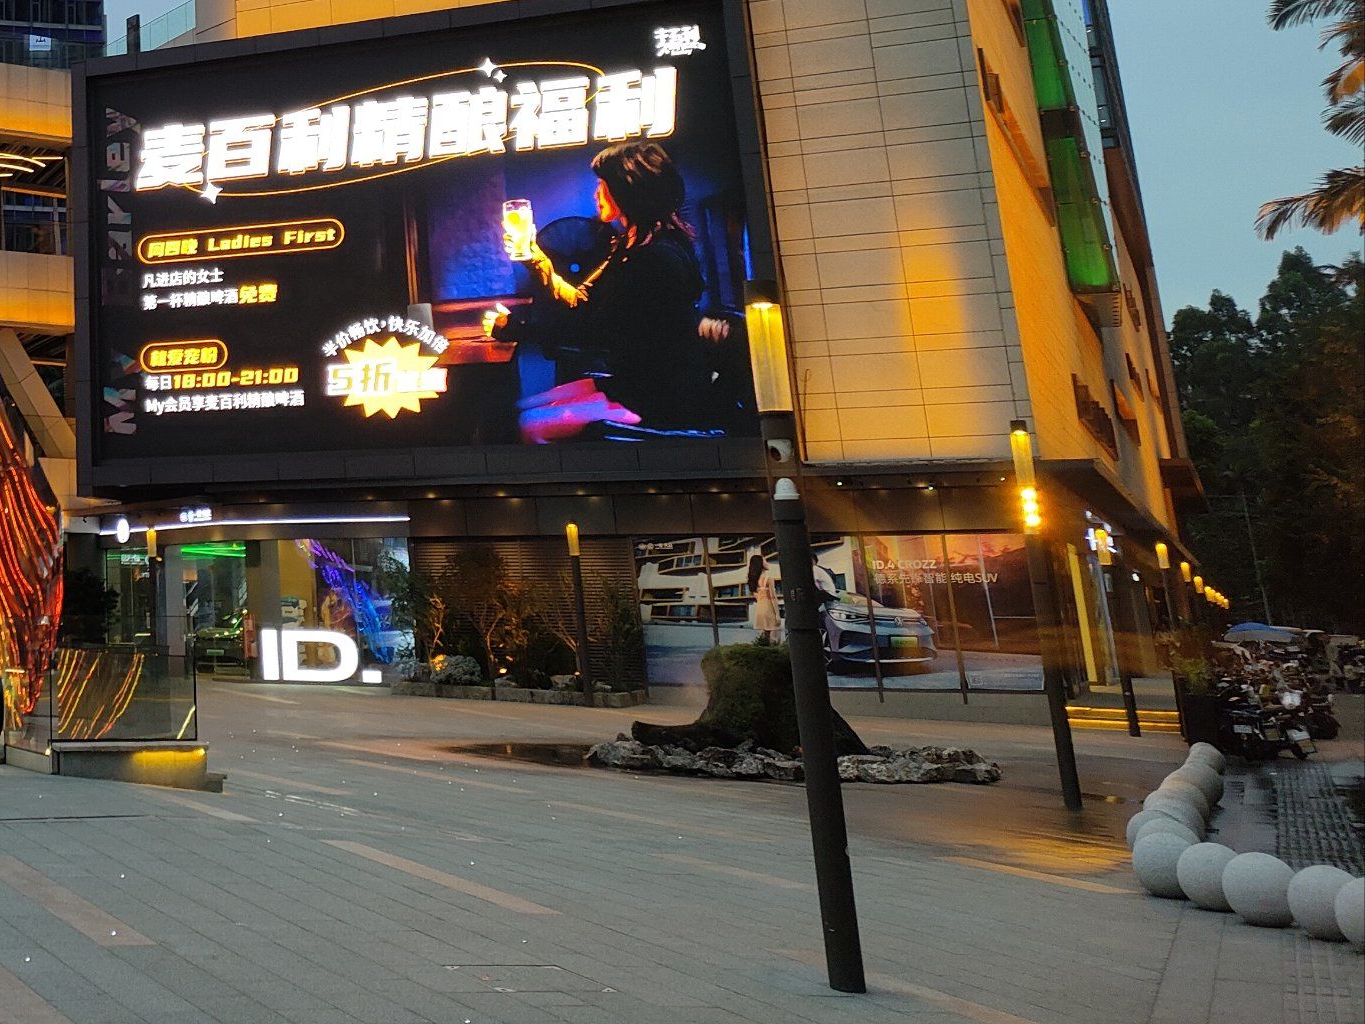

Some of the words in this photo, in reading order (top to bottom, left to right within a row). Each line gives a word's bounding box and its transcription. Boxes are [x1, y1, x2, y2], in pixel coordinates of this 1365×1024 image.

[136, 66, 678, 192] 麦百利精酿福利
[207, 234, 274, 252] Ladies
[283, 228, 336, 245] First
[142, 268, 225, 289] 凡进店的女士
[897, 559, 938, 570] CROZZ
[259, 628, 383, 684] ID.
